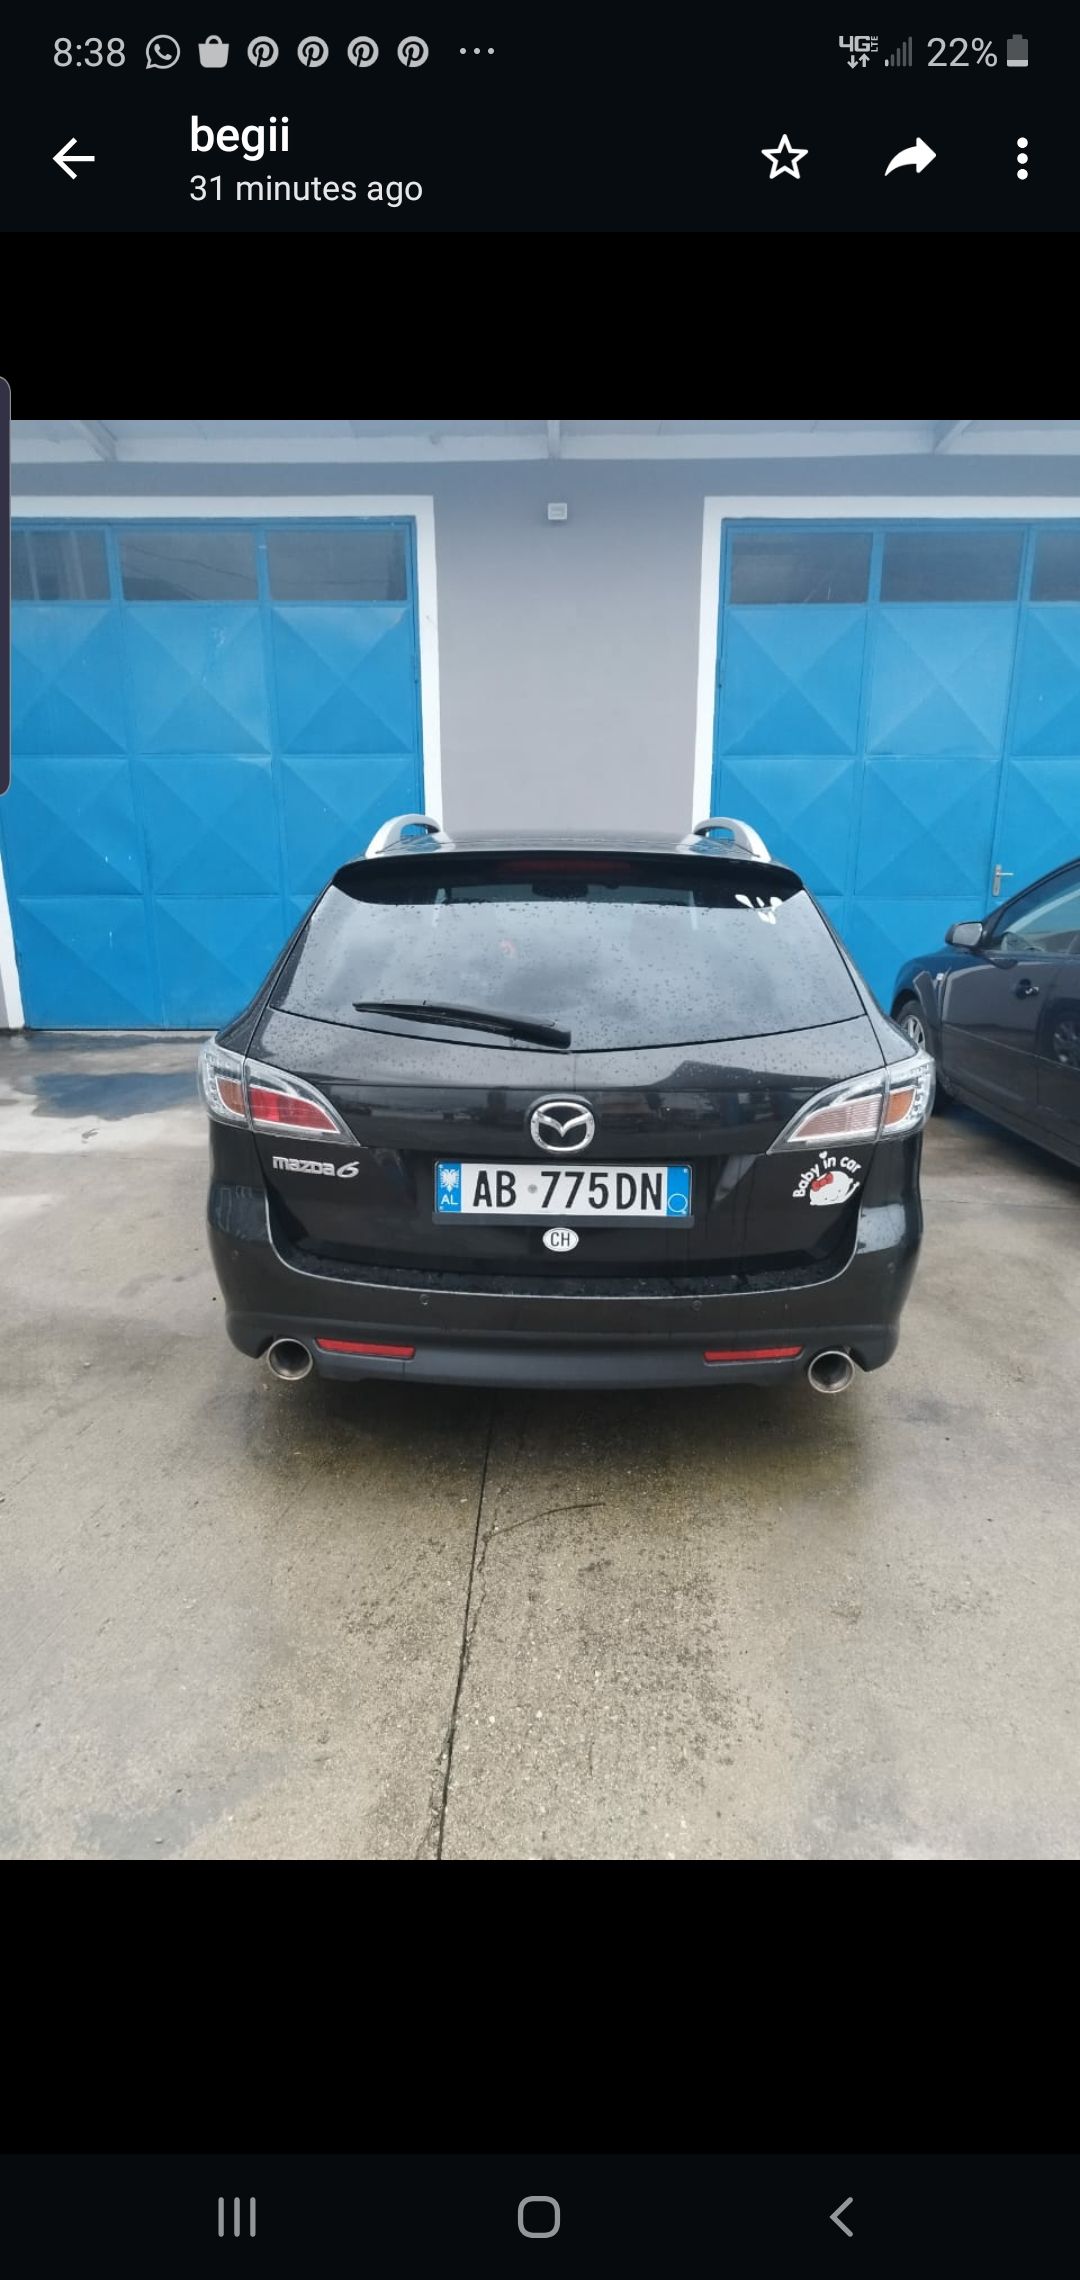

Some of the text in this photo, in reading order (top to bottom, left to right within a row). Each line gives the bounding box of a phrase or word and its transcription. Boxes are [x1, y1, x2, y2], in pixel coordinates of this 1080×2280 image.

[792, 1150, 862, 1198] Baby in car
[440, 1194, 460, 1205] AL
[472, 1170, 663, 1211] AB 775DN
[550, 1232, 571, 1248] CH
